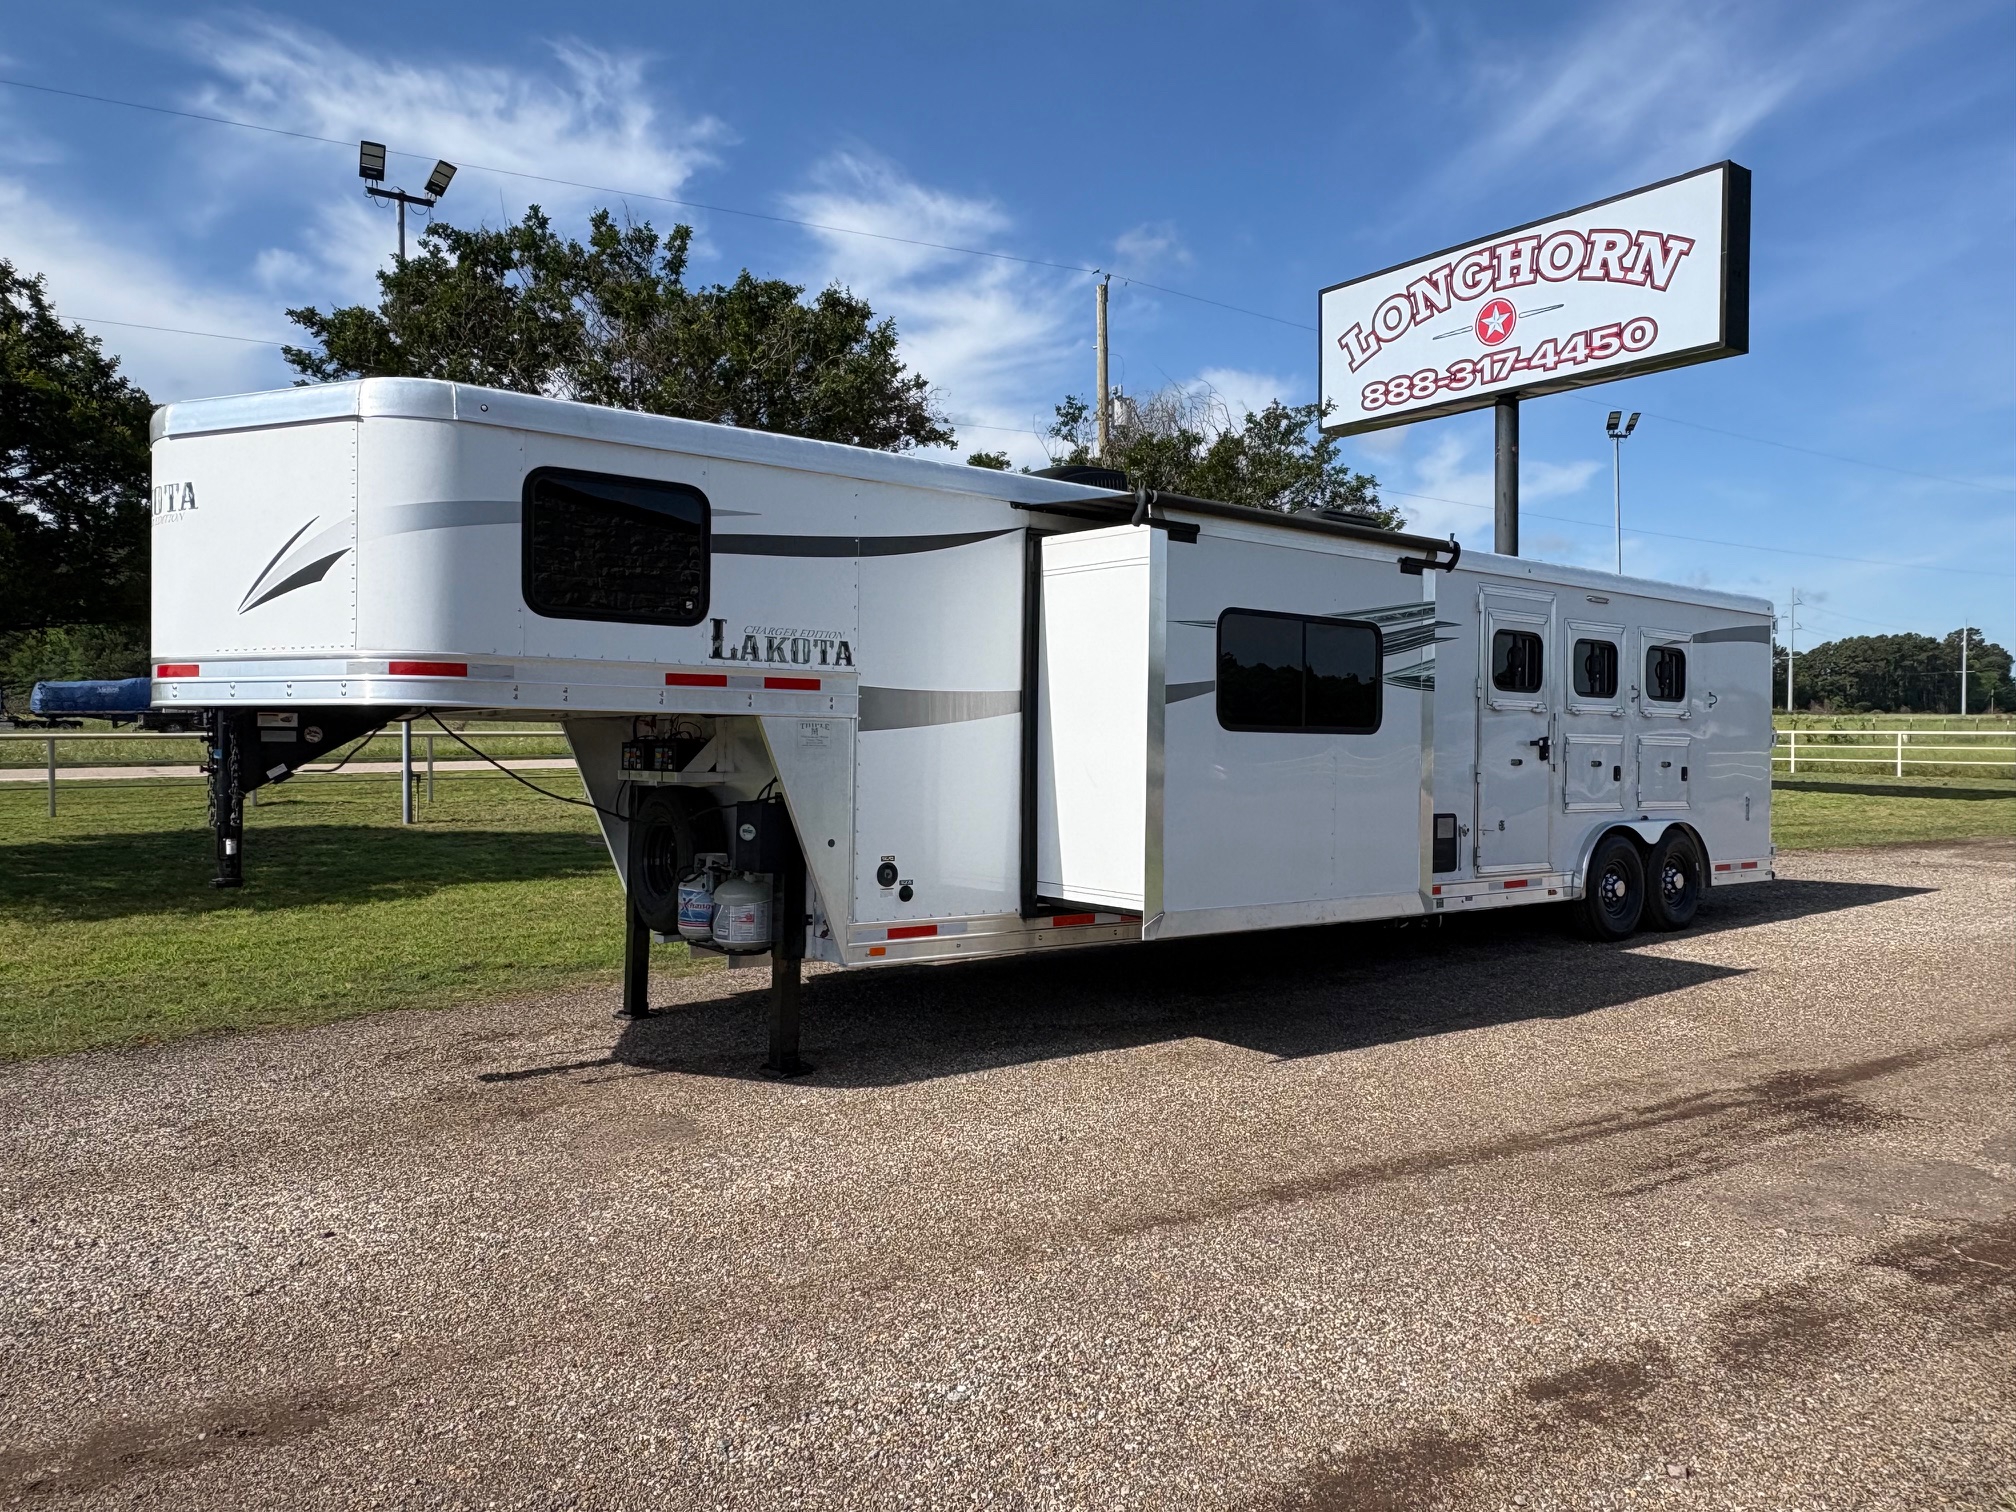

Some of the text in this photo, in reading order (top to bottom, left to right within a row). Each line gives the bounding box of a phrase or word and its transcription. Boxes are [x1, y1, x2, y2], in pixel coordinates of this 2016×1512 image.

[1338, 229, 1696, 373] LONGHORN
[1361, 317, 1659, 411] 888-317-4450
[151, 482, 199, 515] OTA
[709, 618, 856, 667] LAKOTA
[744, 625, 845, 640] CHARGER EDITION
